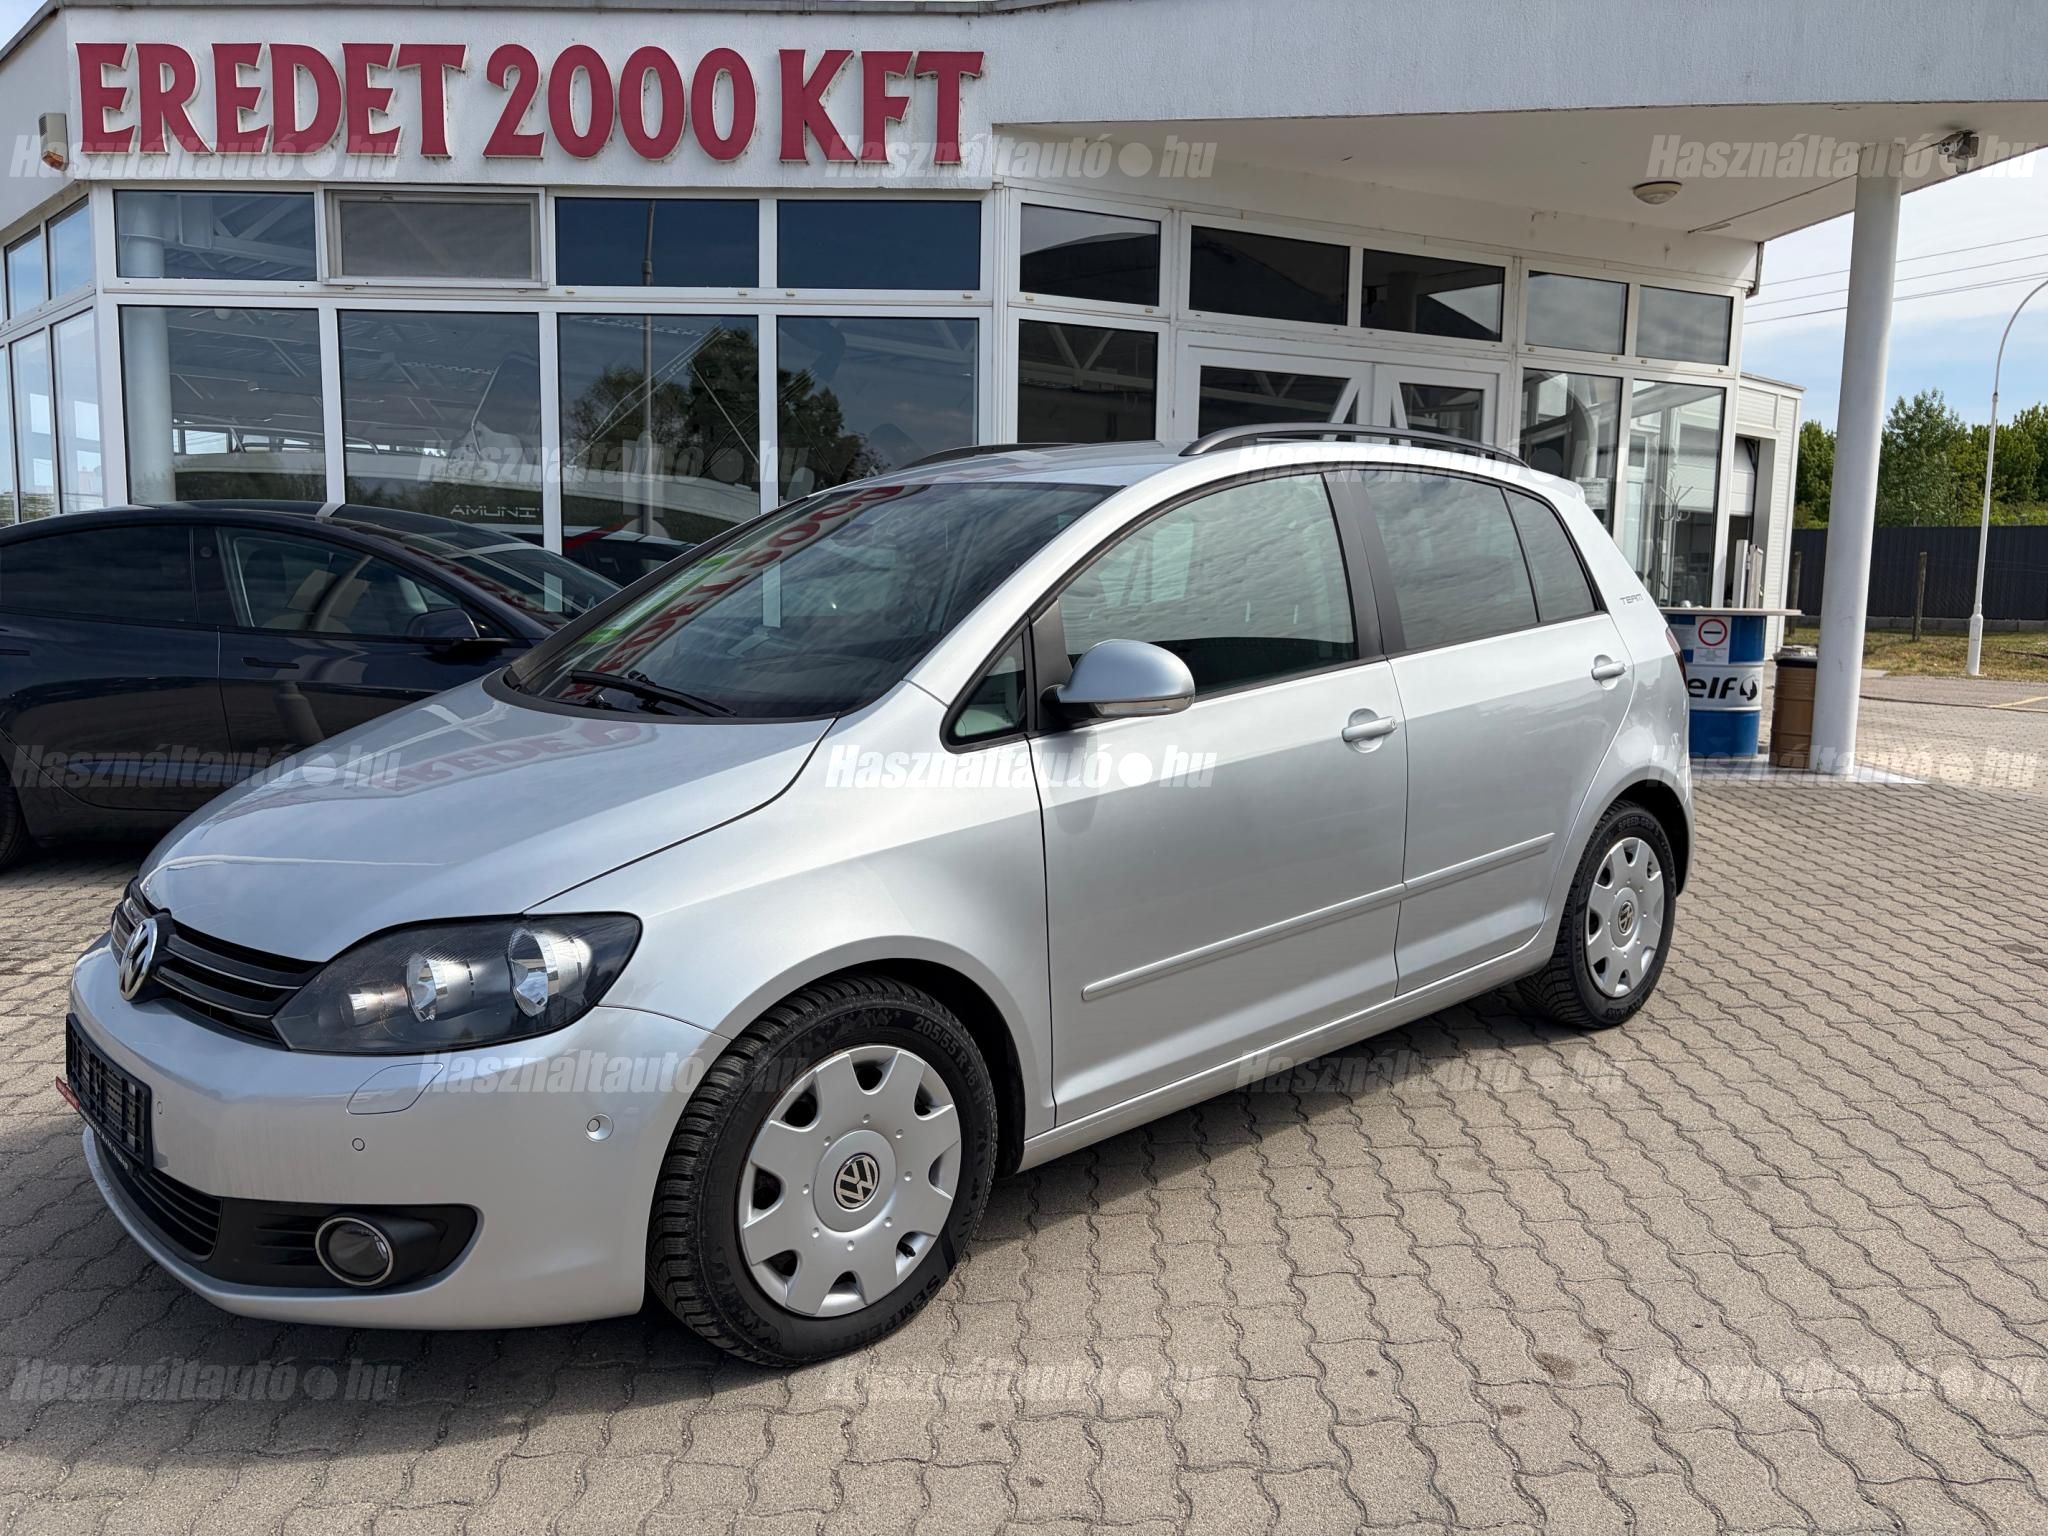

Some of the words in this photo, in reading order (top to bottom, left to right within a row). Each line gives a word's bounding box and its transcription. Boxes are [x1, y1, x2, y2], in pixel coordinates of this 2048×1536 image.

[76, 42, 466, 157] EREDET
[483, 43, 758, 161] 2000
[778, 49, 984, 164] KFT
[1687, 677, 1738, 699] elf
[912, 1015, 960, 1057] 205/55
[955, 1052, 968, 1069] R
[964, 1065, 979, 1087] 16
